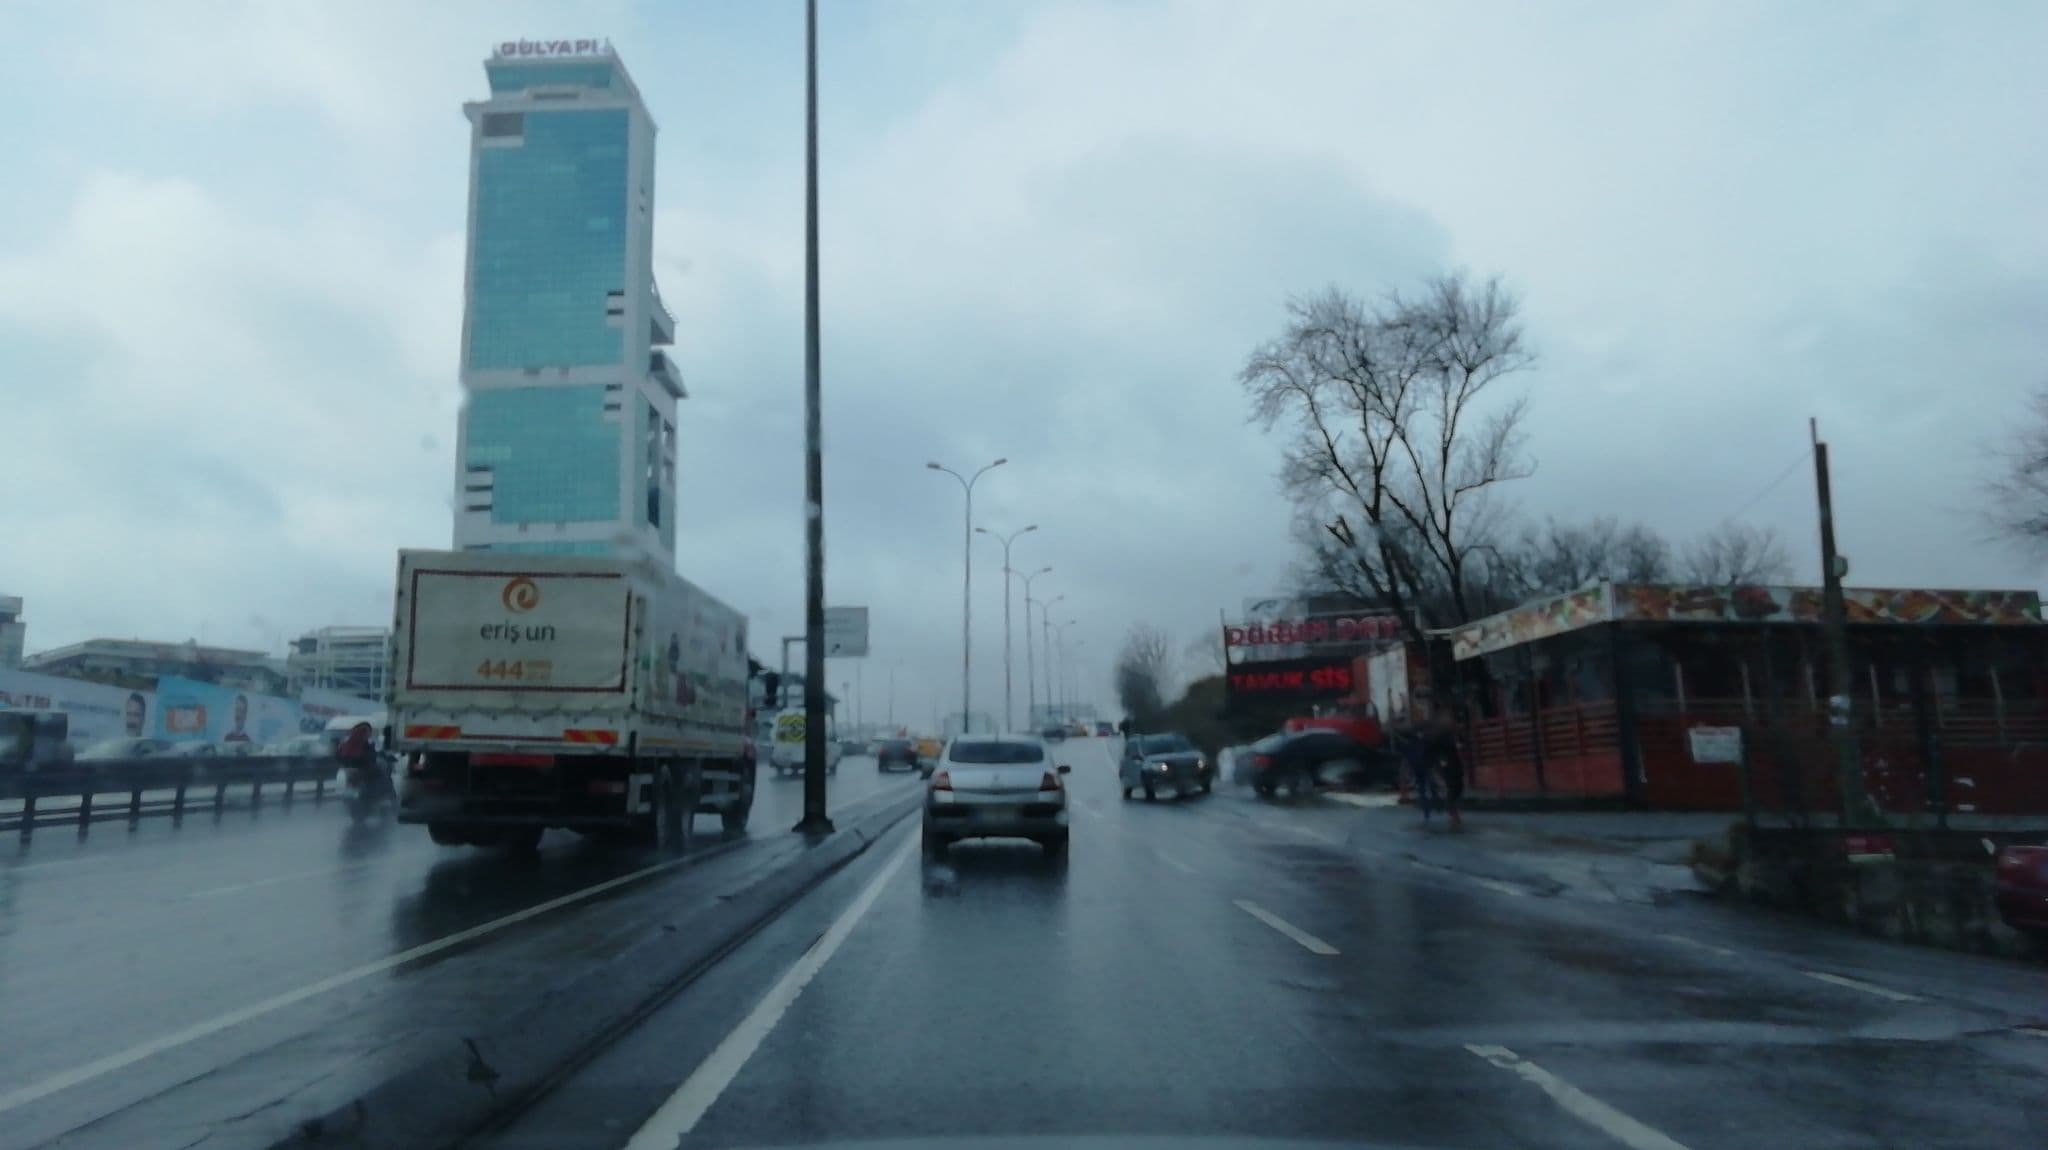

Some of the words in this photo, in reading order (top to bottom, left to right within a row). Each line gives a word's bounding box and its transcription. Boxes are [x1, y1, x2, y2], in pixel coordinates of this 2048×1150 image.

[480, 619, 520, 644] eriş
[526, 624, 556, 641] un
[477, 658, 523, 679] 444
